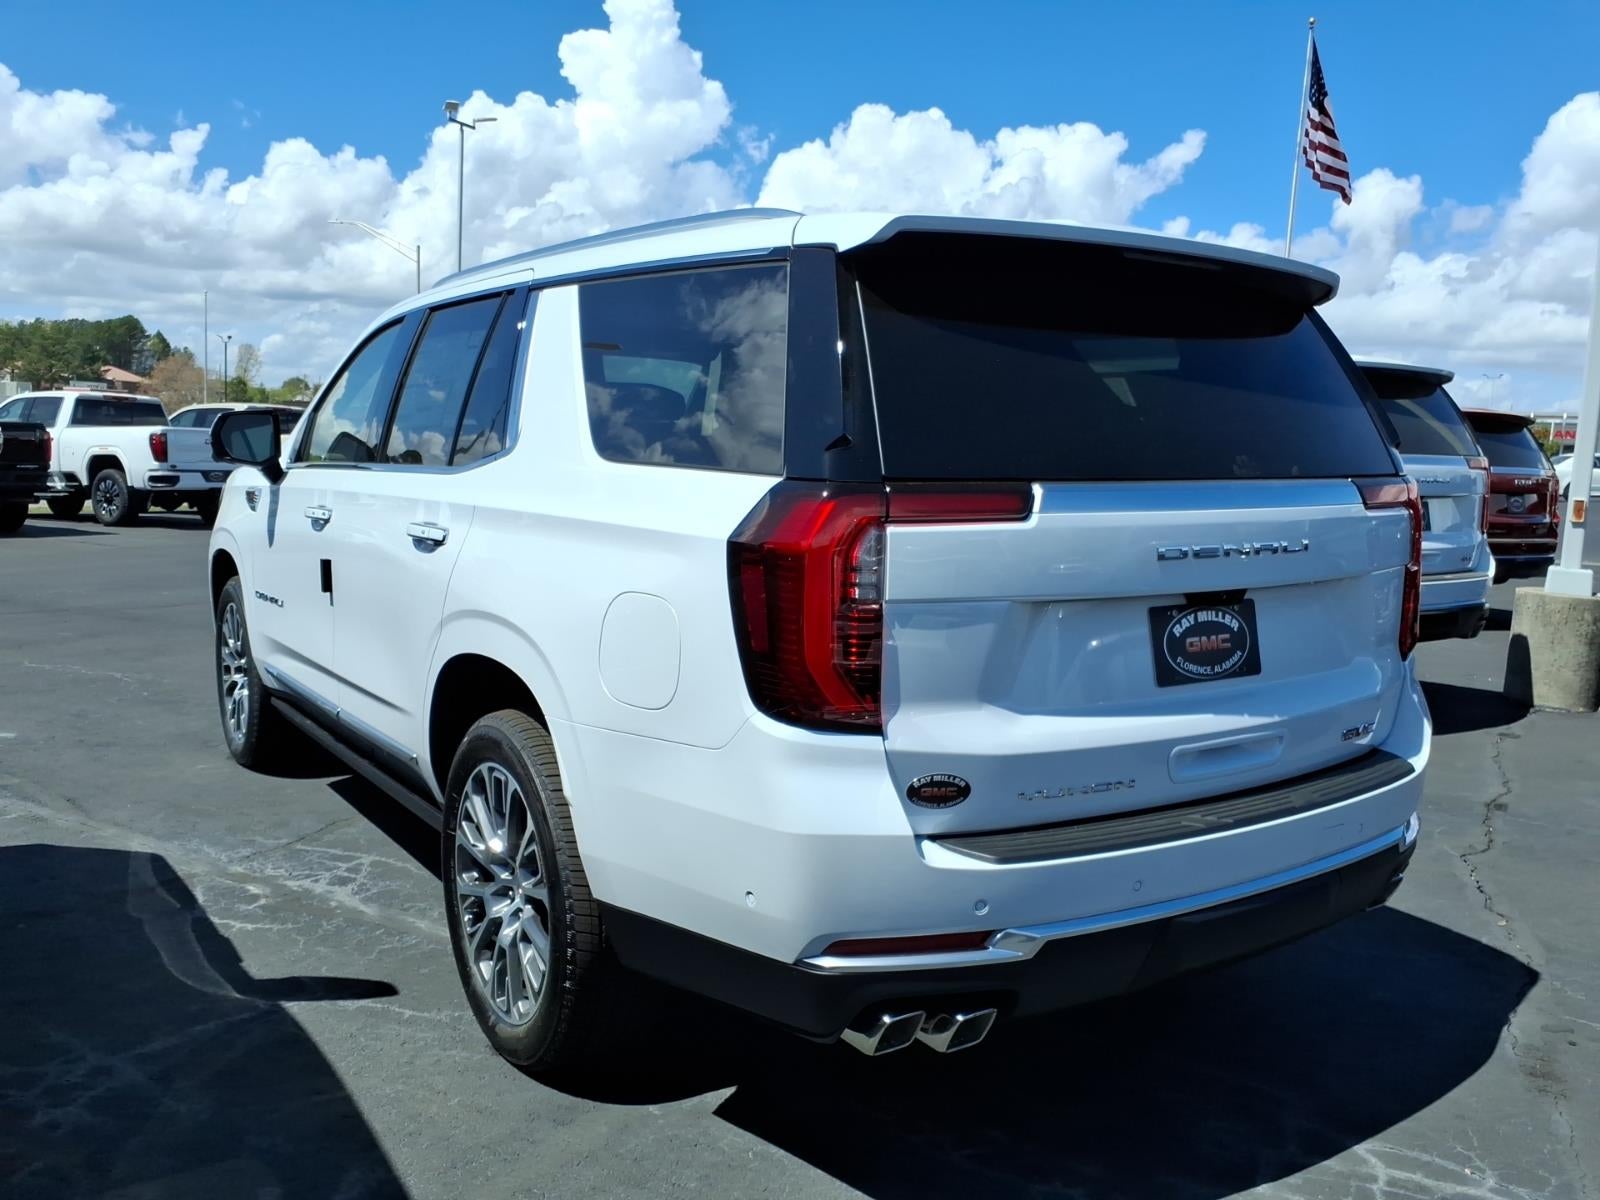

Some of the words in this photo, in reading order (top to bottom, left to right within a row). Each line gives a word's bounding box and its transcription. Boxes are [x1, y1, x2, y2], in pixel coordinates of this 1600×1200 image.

[1157, 539, 1309, 561] DENALI
[255, 590, 284, 608] DENALI
[1173, 613, 1195, 637] RAY
[1197, 610, 1239, 632] MILLER
[1186, 633, 1231, 652] GMC
[1176, 656, 1214, 675] FLORENCE,
[1214, 650, 1242, 673] ALABAMA
[913, 776, 932, 788] RAY
[933, 775, 966, 788] MILLER
[920, 787, 958, 797] GMC
